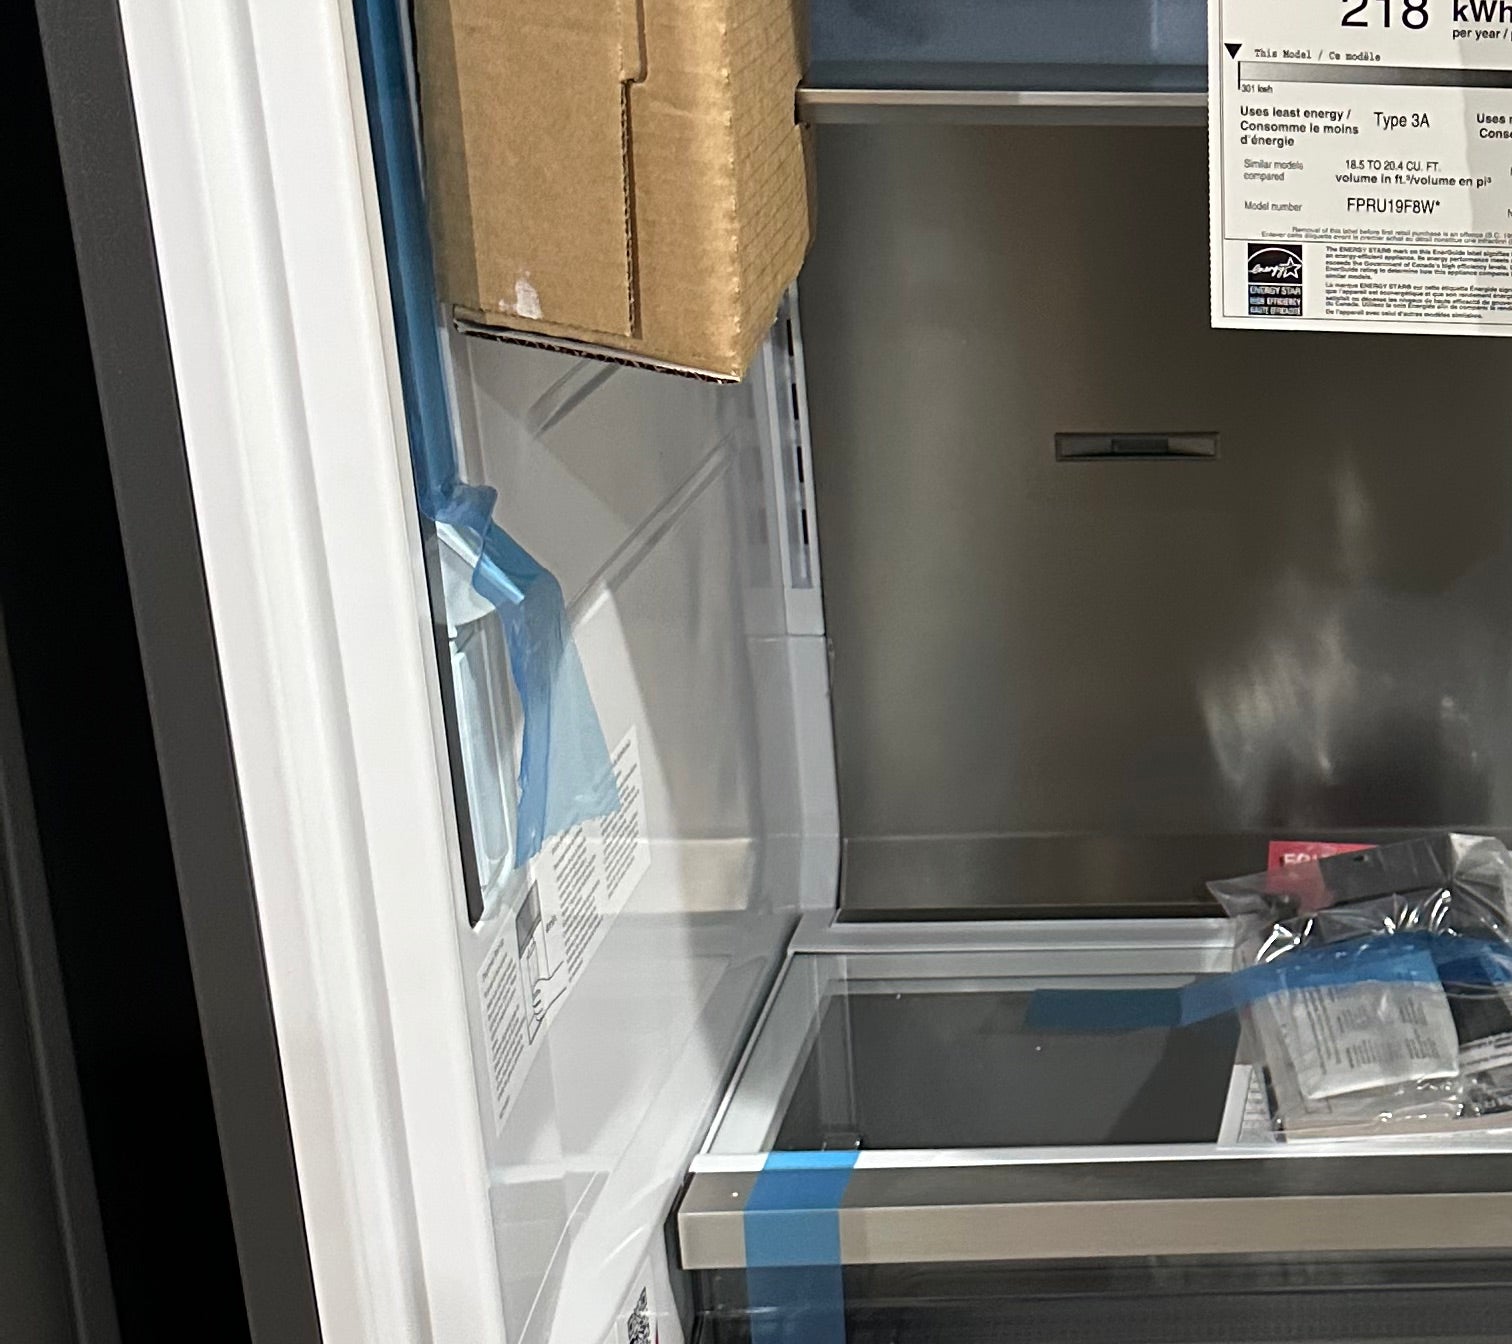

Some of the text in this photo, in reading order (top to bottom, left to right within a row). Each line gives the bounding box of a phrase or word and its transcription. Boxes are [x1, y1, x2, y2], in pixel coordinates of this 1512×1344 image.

[1452, 29, 1472, 40] per
[1476, 30, 1500, 40] year
[1254, 48, 1277, 58] This
[1283, 49, 1312, 59] Model
[1329, 51, 1341, 60] Ce
[1240, 106, 1269, 116] Uses
[1273, 107, 1300, 118] least
[1304, 109, 1344, 121] energy
[1477, 113, 1505, 124] Uses
[1374, 112, 1430, 130] Type 3A
[1240, 121, 1359, 134] Consomme le moins
[1244, 159, 1304, 170] Similar models
[1345, 160, 1365, 170] 18.5
[1369, 160, 1381, 170] TO
[1384, 160, 1404, 171] 20.4
[1244, 172, 1285, 182] compared
[1336, 173, 1378, 184] volume
[1381, 174, 1391, 184] in
[1244, 201, 1302, 212] Model number
